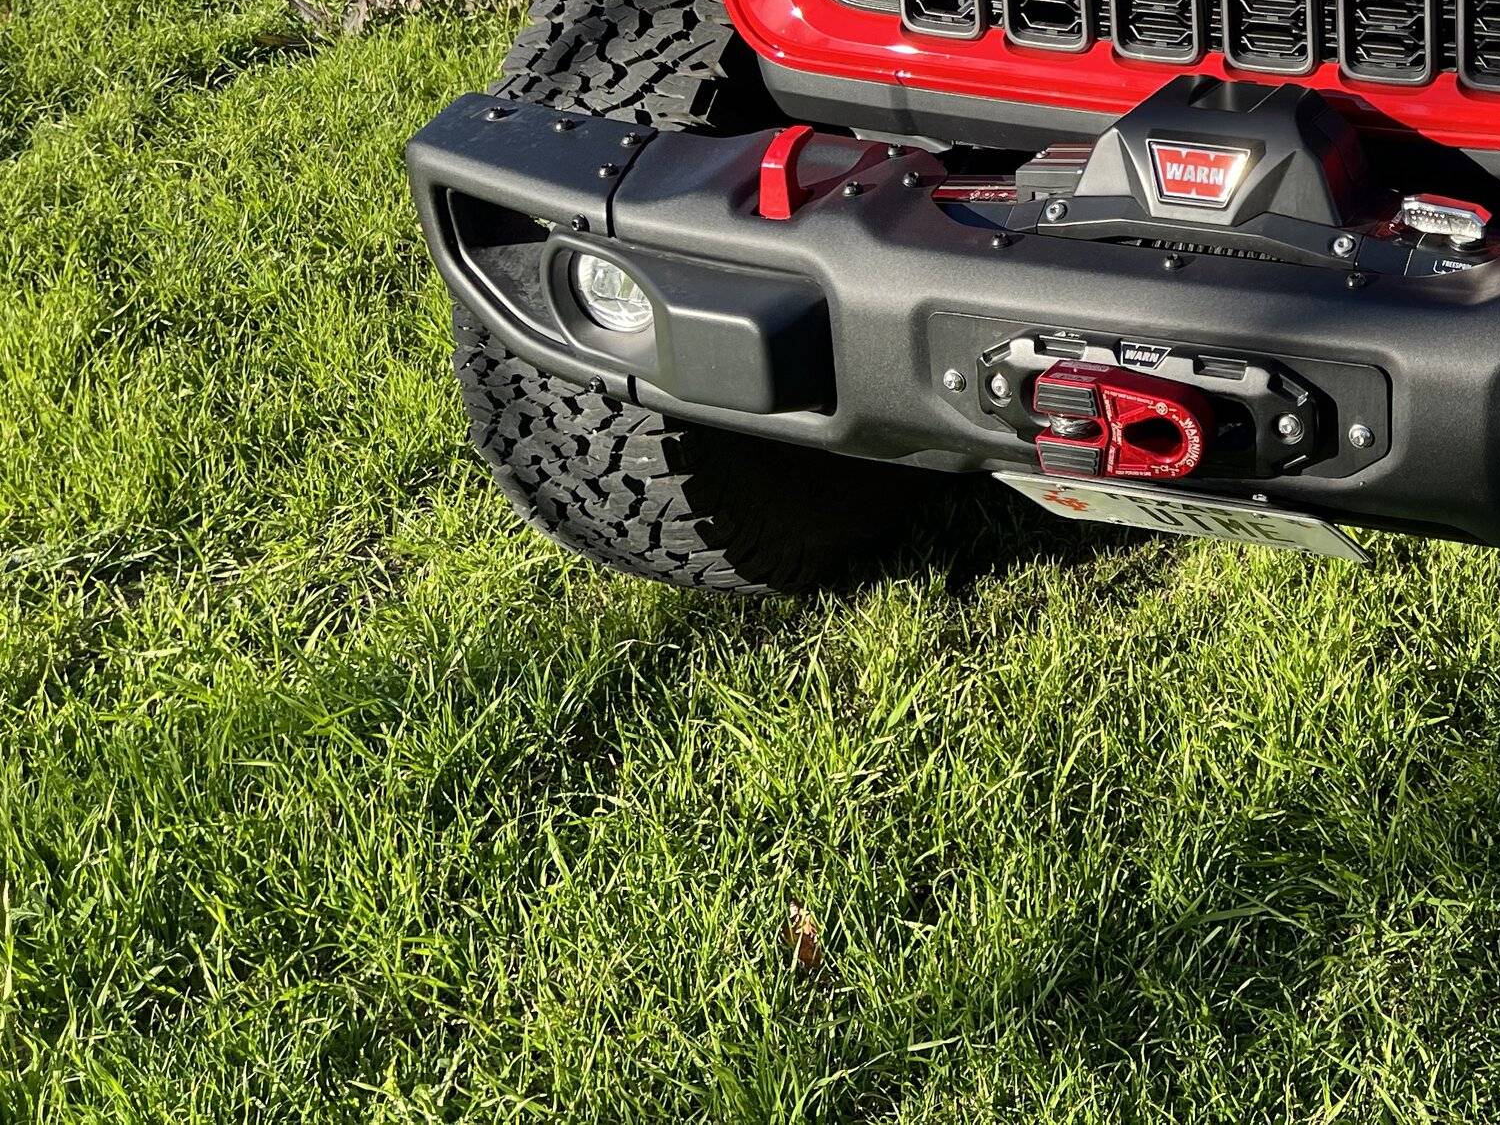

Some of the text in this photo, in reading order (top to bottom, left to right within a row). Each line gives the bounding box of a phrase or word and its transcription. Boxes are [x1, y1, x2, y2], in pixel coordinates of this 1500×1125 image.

[1166, 162, 1225, 186] WARN
[1124, 349, 1160, 363] WARN
[1183, 417, 1201, 468] WARNING
[1136, 505, 1296, 543] UTME
